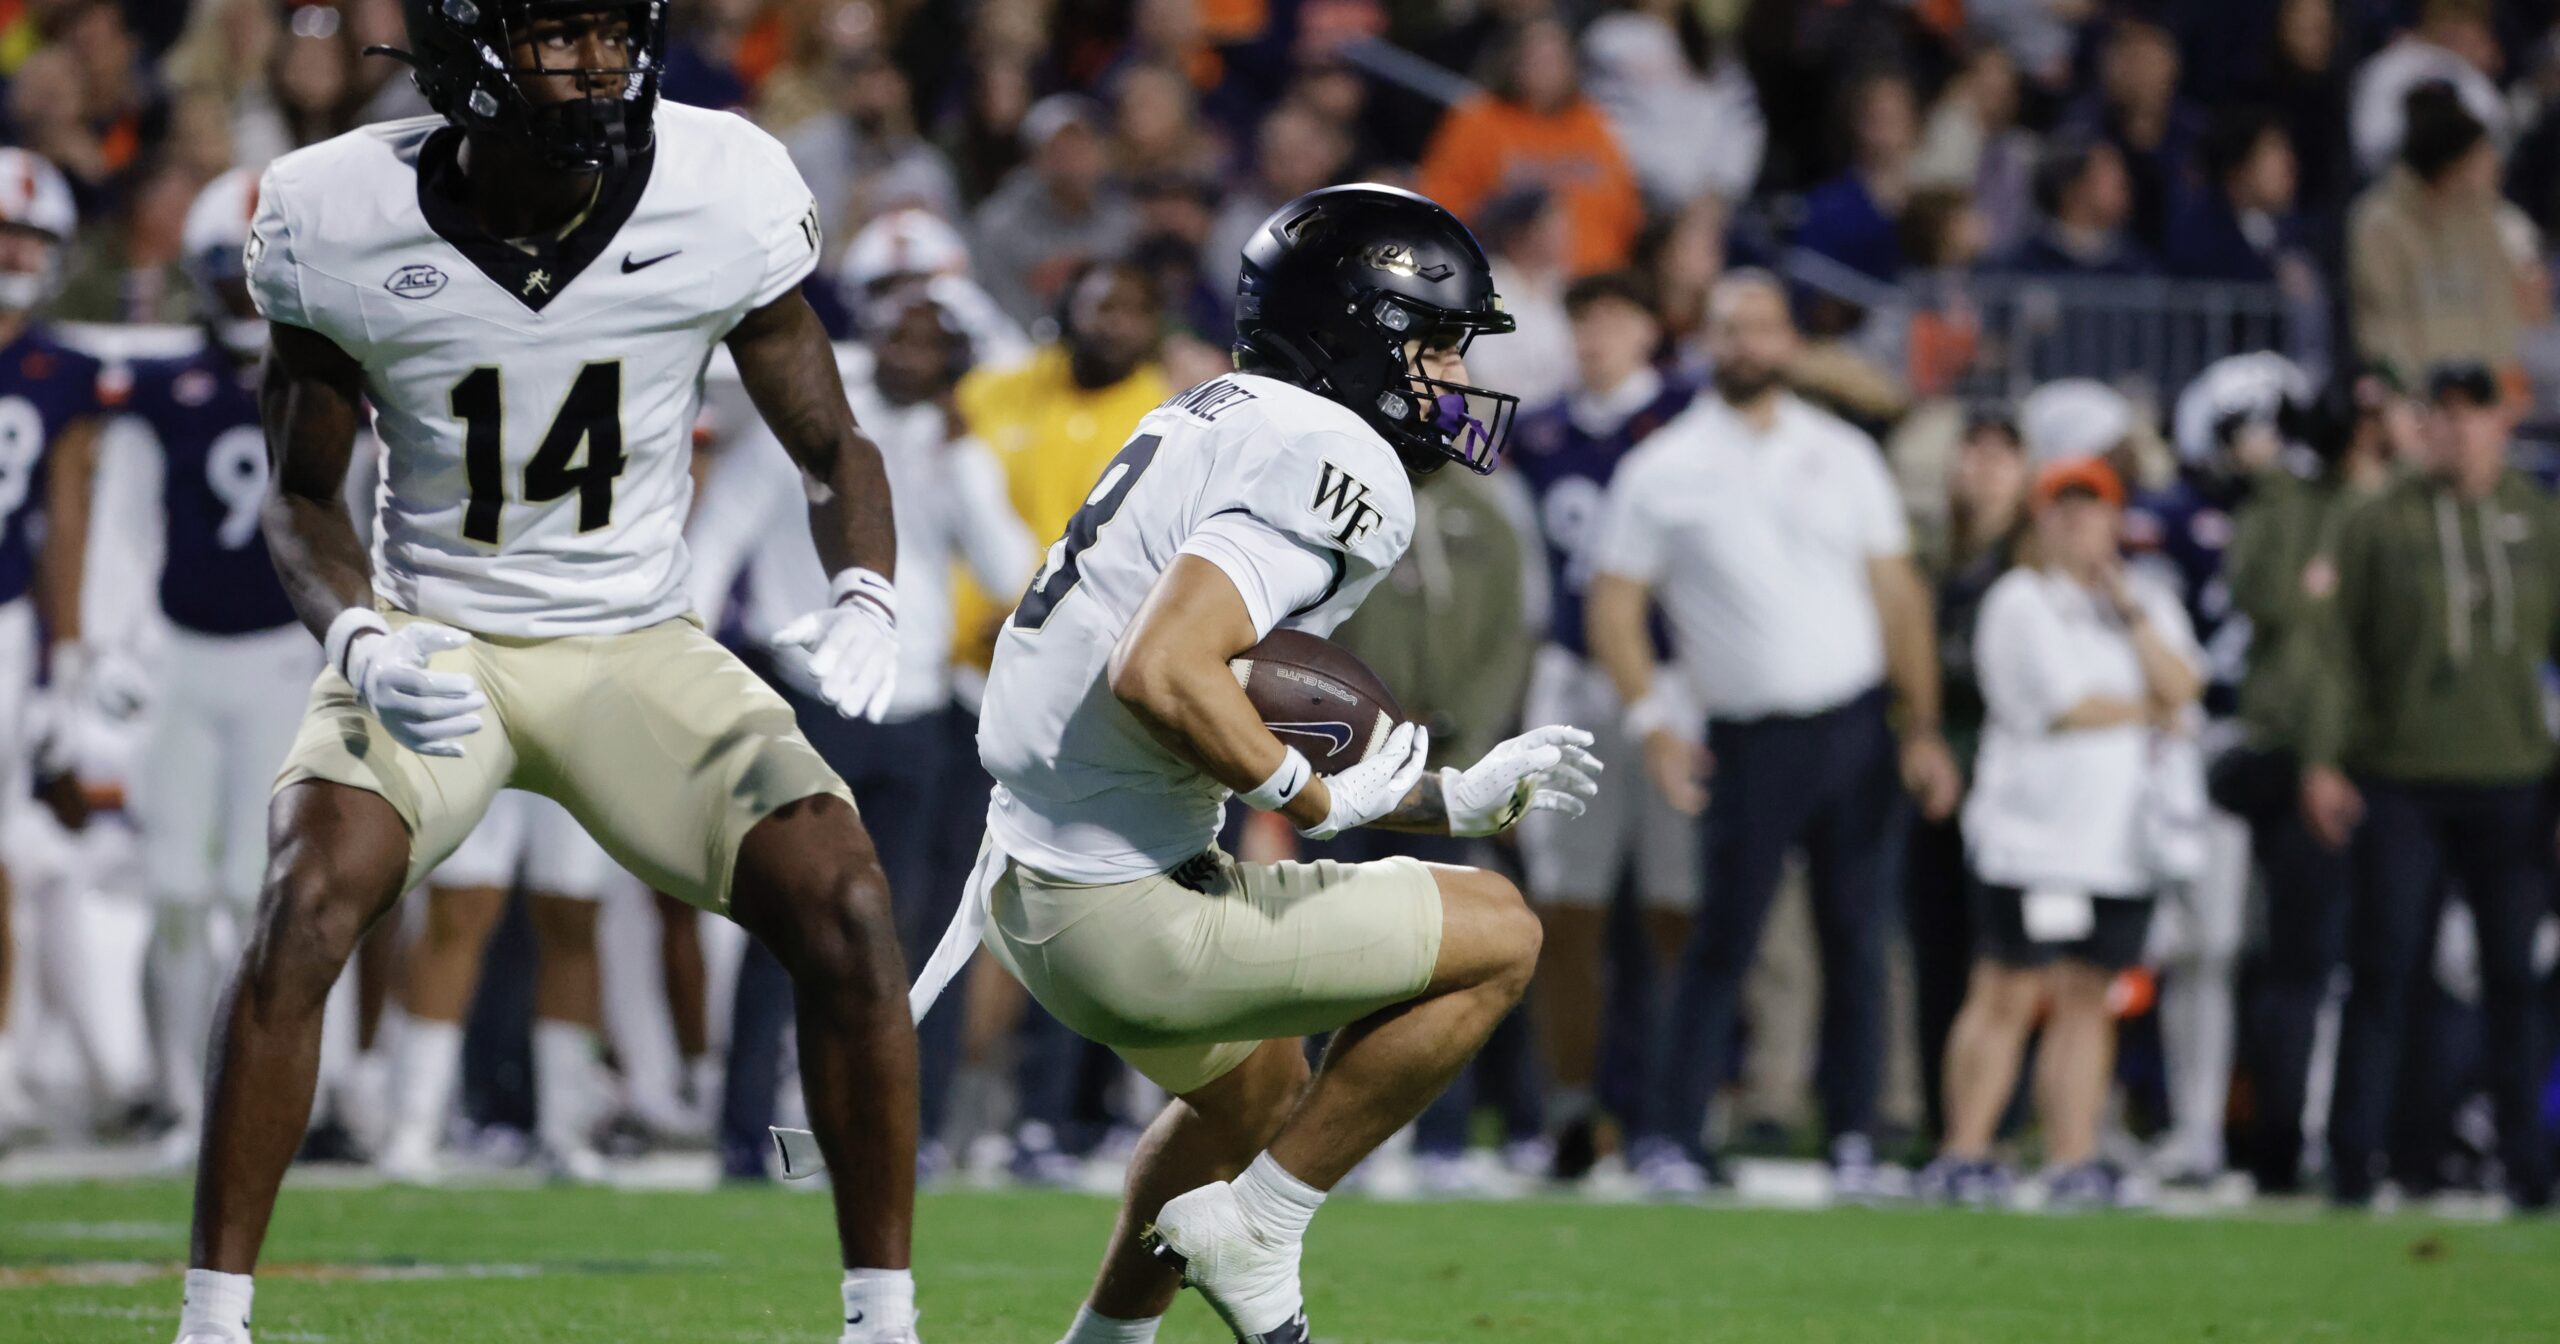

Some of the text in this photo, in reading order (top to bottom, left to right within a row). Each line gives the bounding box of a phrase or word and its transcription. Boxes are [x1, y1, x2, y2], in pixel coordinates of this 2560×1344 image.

[394, 272, 437, 289] ACC
[448, 356, 629, 545] 14
[1310, 458, 1385, 548] WF
[1276, 667, 1358, 706] VAPOR ELITE
